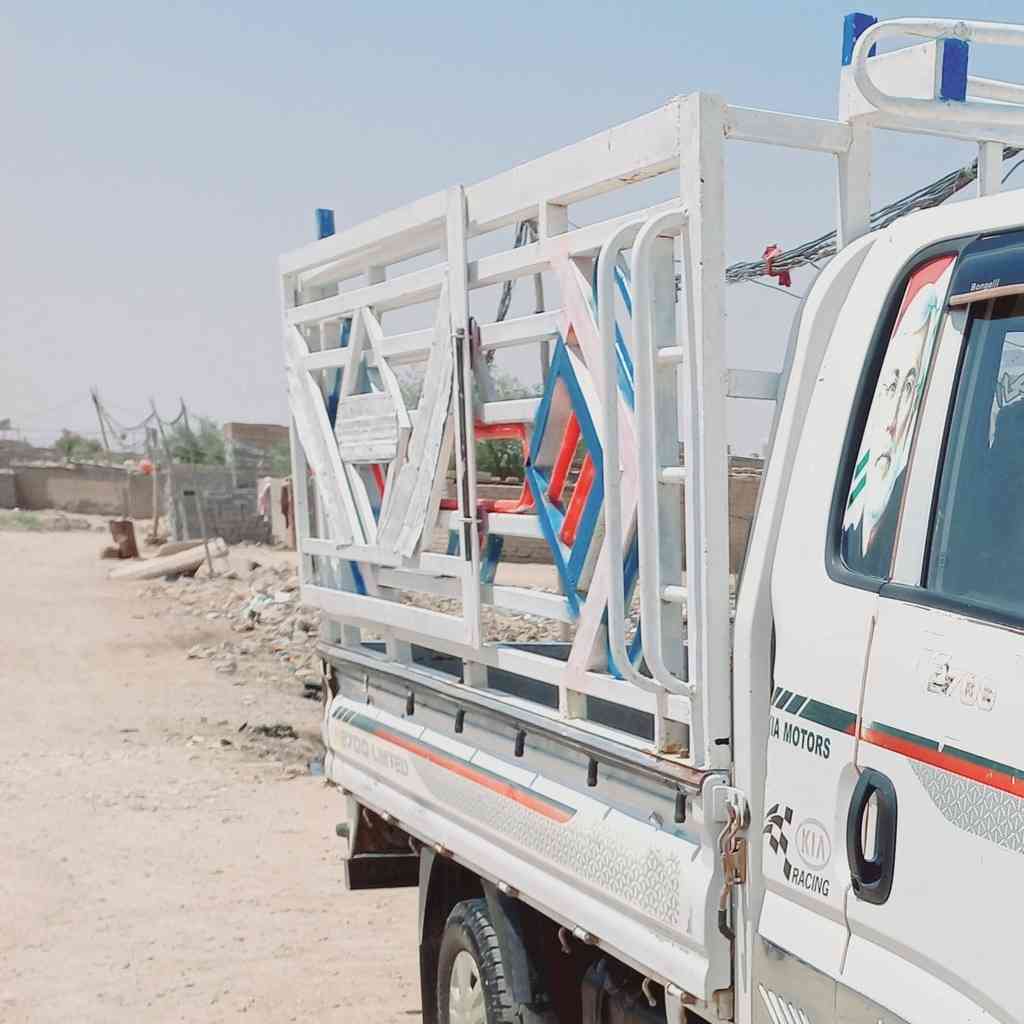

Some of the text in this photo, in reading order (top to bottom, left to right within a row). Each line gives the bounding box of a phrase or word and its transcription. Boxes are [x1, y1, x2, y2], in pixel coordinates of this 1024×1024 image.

[783, 721, 831, 759] MOTORS
[800, 826, 827, 864] KIA
[791, 867, 830, 897] RACING
